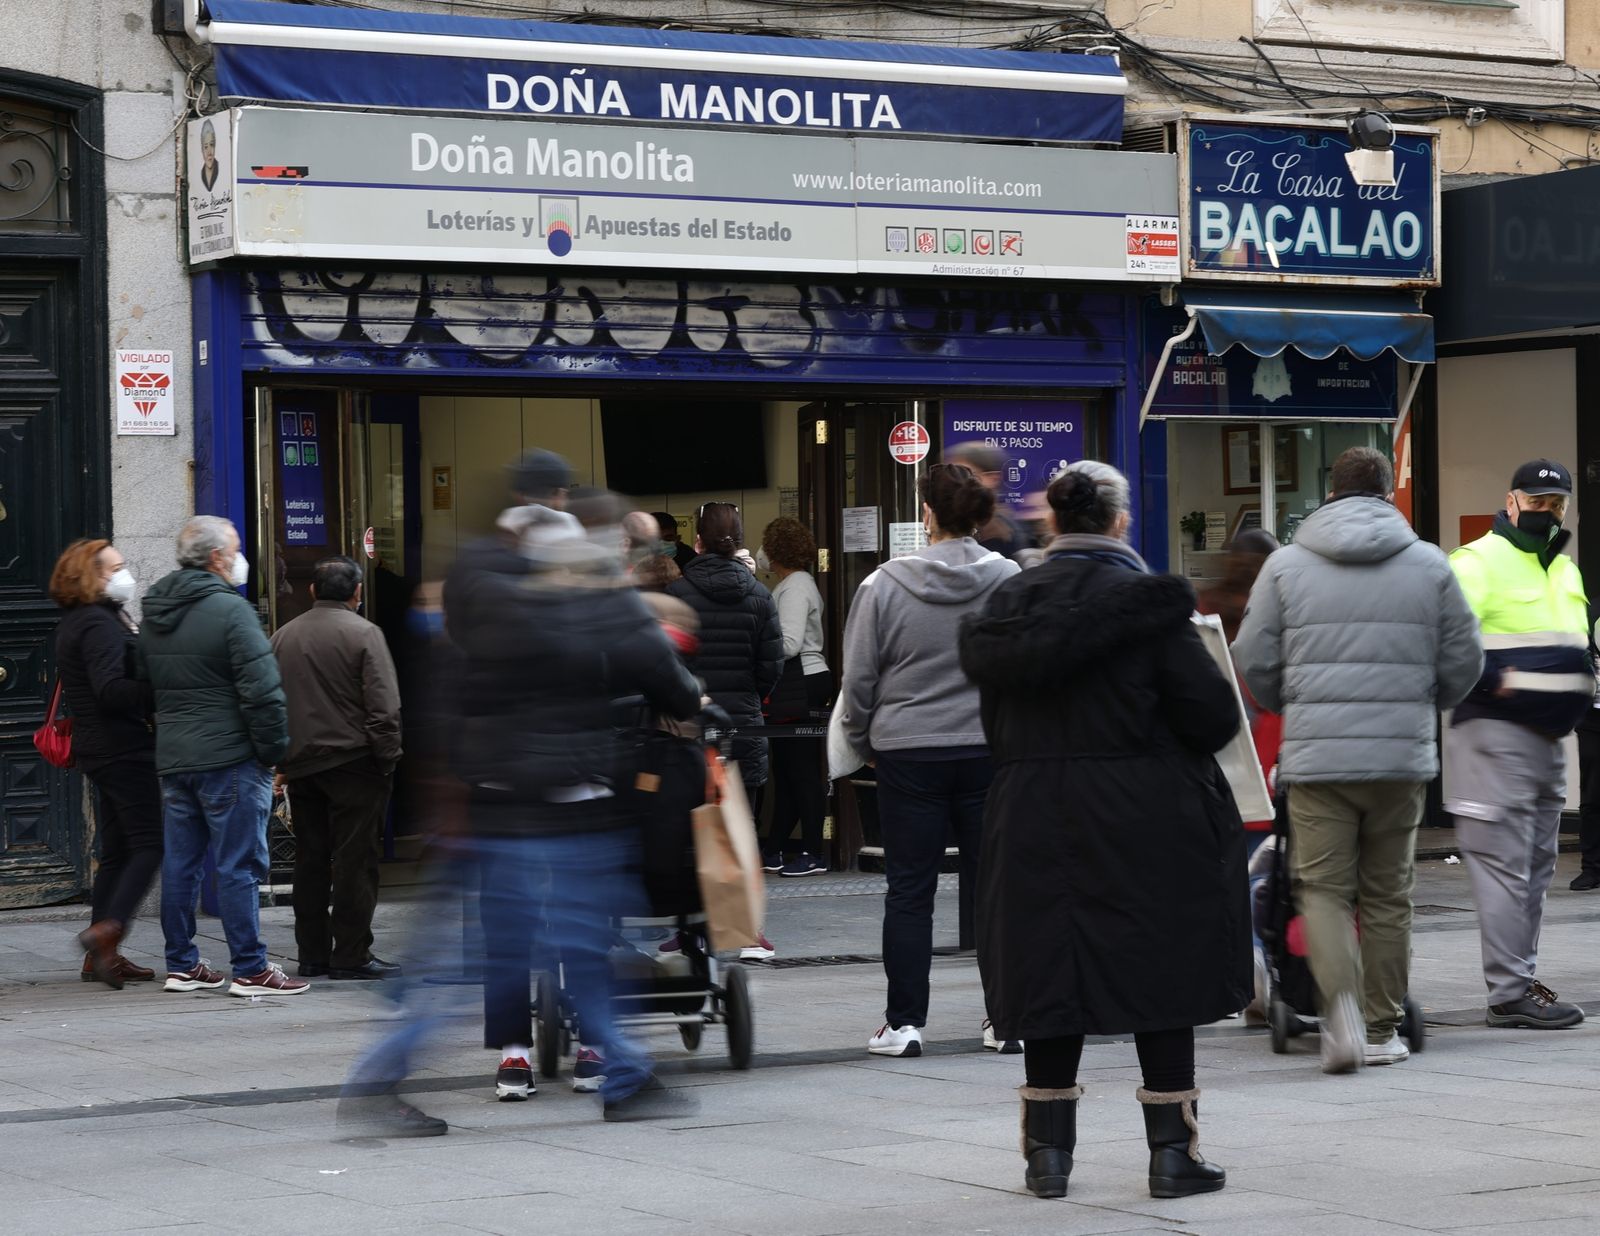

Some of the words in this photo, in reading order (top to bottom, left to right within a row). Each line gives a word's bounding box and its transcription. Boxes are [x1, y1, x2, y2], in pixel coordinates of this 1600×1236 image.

[486, 68, 631, 116] DOÑA
[660, 82, 902, 130] MANOLITA
[410, 132, 514, 175] Doña
[526, 137, 694, 182] Manolita
[1217, 150, 1263, 194] La
[1272, 152, 1345, 197] Casa
[792, 171, 1042, 198] www.loteriamanolita.com
[427, 209, 516, 233] Loterías
[522, 216, 535, 238] y
[585, 214, 681, 239] Apuestas
[687, 217, 718, 240] del
[724, 220, 792, 243] Estado
[1126, 219, 1178, 230] ALARMA
[1199, 201, 1423, 260] BACALAO
[1150, 239, 1177, 247] LASSER
[932, 264, 999, 277] Administración
[1013, 266, 1025, 276] 67
[1130, 259, 1147, 269] 24h
[119, 353, 170, 364] VIGILADO
[1172, 370, 1227, 386] BACALAO
[896, 426, 919, 440] +18
[953, 420, 1002, 433] DISFRUTE
[1004, 421, 1017, 433] DE
[1019, 421, 1034, 433] SU
[1035, 421, 1073, 434] TIEMPO
[984, 437, 999, 449] EN
[1000, 437, 1008, 449] 3
[1009, 437, 1043, 449] PASOS
[285, 500, 310, 510] Loterías
[286, 514, 314, 527] Apuestas
[315, 514, 324, 525] del
[288, 529, 308, 540] Estado
